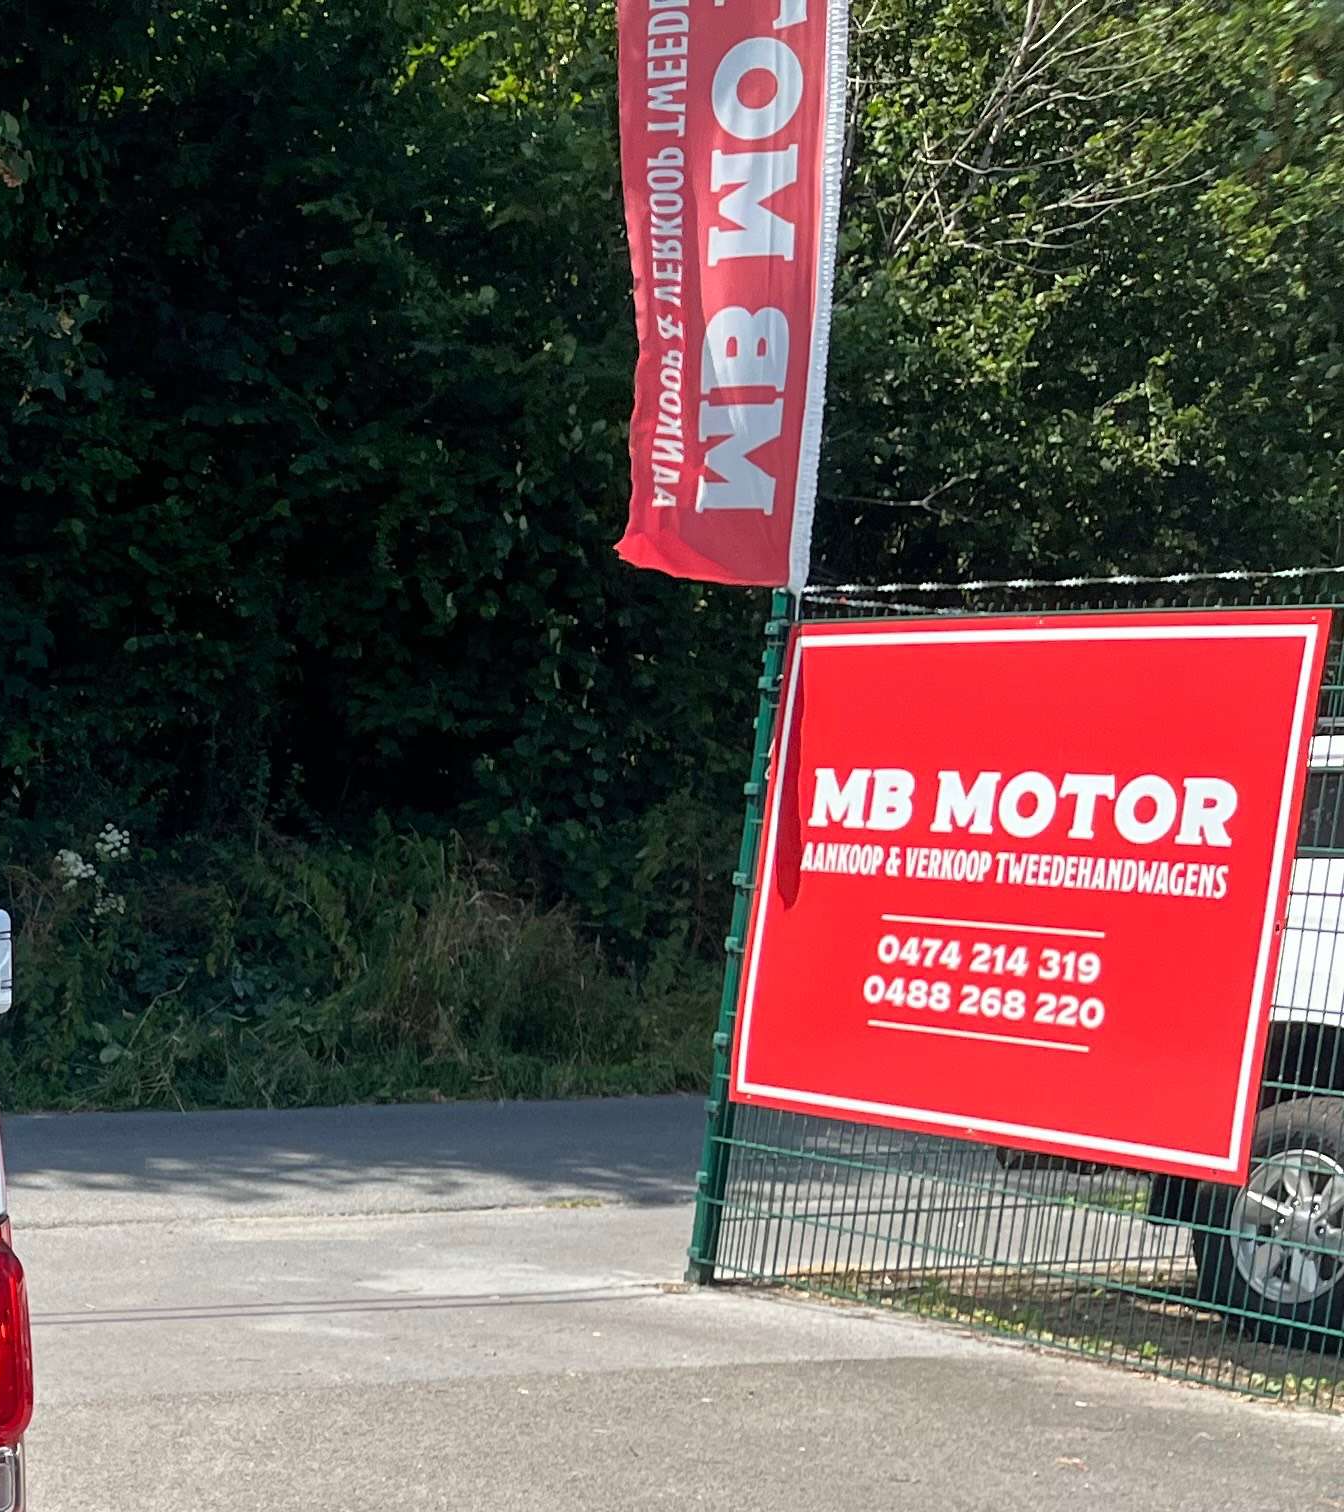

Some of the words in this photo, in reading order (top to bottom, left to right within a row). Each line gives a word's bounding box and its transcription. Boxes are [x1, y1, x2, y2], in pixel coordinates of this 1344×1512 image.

[807, 767, 916, 831] MB
[929, 770, 1238, 848] MOTOR
[800, 842, 885, 876] AANKOOP
[885, 845, 902, 877] &
[905, 847, 992, 884] VERKOOP
[995, 851, 1230, 900] TWEEDEHANDWAGENS
[877, 934, 962, 971] 0474
[969, 942, 1030, 977] 214
[1037, 948, 1102, 984] 319
[863, 974, 952, 1012] 0488
[958, 984, 1027, 1021] 268
[1033, 992, 1106, 1030] 220
